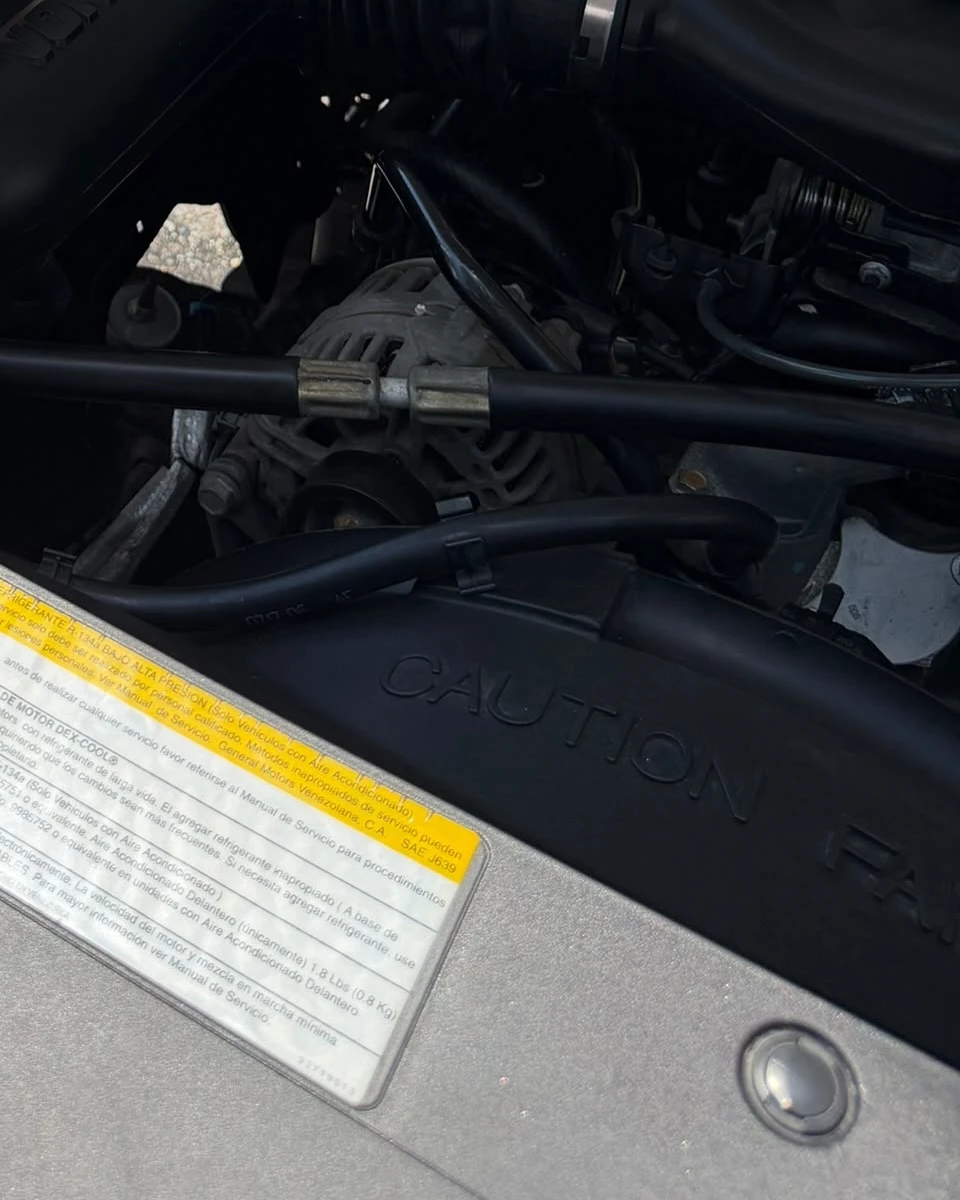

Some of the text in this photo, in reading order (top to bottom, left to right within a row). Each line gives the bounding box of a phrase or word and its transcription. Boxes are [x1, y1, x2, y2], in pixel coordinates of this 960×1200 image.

[0, 692, 16, 706] DE
[15, 701, 55, 729] MOTOR
[3, 657, 30, 675] antes
[29, 670, 42, 683] de
[43, 680, 77, 703] realizar
[77, 700, 121, 728] cualquier
[121, 725, 158, 750] servicio
[159, 744, 186, 765] favor
[185, 761, 226, 788] referirse
[239, 789, 279, 816] Manual
[293, 819, 336, 848] Servicio
[336, 844, 362, 862] para
[362, 858, 446, 908] procedimientos
[4, 621, 41, 647] lesiones
[97, 674, 115, 688] Ver
[115, 684, 152, 709] Manual
[169, 714, 210, 743] Servicio.
[217, 740, 259, 768] General
[259, 763, 295, 788] Motors
[400, 838, 426, 858] SAE
[427, 852, 457, 874] J639
[46, 630, 71, 648] debe
[88, 655, 131, 683] realizado
[149, 690, 193, 717] personal
[193, 714, 241, 744] calificado.
[290, 764, 358, 806] inapropiados
[359, 801, 374, 815] de
[375, 811, 418, 838] servicio
[418, 834, 462, 861] pueden
[130, 660, 330, 775] ALTA (Solo con Aire
[379, 652, 768, 824] CAUTION
[21, 723, 38, 736] con
[39, 734, 94, 769] refrigerante
[94, 763, 108, 776] de
[108, 771, 134, 791] larga
[134, 787, 156, 805] vida.
[160, 800, 173, 813] El
[172, 809, 212, 836] agregar
[212, 832, 272, 870] refrigerante
[272, 864, 335, 906] inapropiado
[353, 909, 382, 932] base
[24, 778, 52, 800] (Solo
[100, 824, 119, 839] con
[119, 833, 141, 852] Aire
[141, 846, 216, 896] Acondicionado
[40, 751, 62, 766] que
[61, 760, 77, 775] los
[77, 772, 118, 800] cambios
[118, 796, 144, 815] sean
[144, 811, 167, 828] más
[237, 864, 281, 893] necesita
[282, 890, 325, 918] agregar
[393, 952, 416, 969] use
[31, 872, 56, 893] Para
[55, 889, 88, 912] mayor
[89, 907, 148, 950] información
[148, 946, 167, 961] ver
[167, 955, 209, 986] Manual
[60, 834, 117, 872] equivalente
[117, 868, 132, 881] en
[132, 878, 179, 910] unidades
[179, 906, 200, 922] con
[200, 916, 223, 936] Aire
[223, 930, 303, 983] Acondicionado
[304, 977, 359, 1016] Delantero
[88, 891, 138, 925] velocidad
[137, 919, 156, 936] del
[155, 932, 187, 956] motor
[195, 957, 235, 985] mezcla
[251, 990, 294, 1020] marcha
[295, 1016, 338, 1046] mínima
[89, 833, 111, 851] Aire
[111, 846, 185, 895] Acondicionado
[185, 889, 236, 926] Delantero
[310, 962, 328, 979] 1.8
[328, 973, 350, 992] Lbs
[375, 1000, 398, 1022] Kg)
